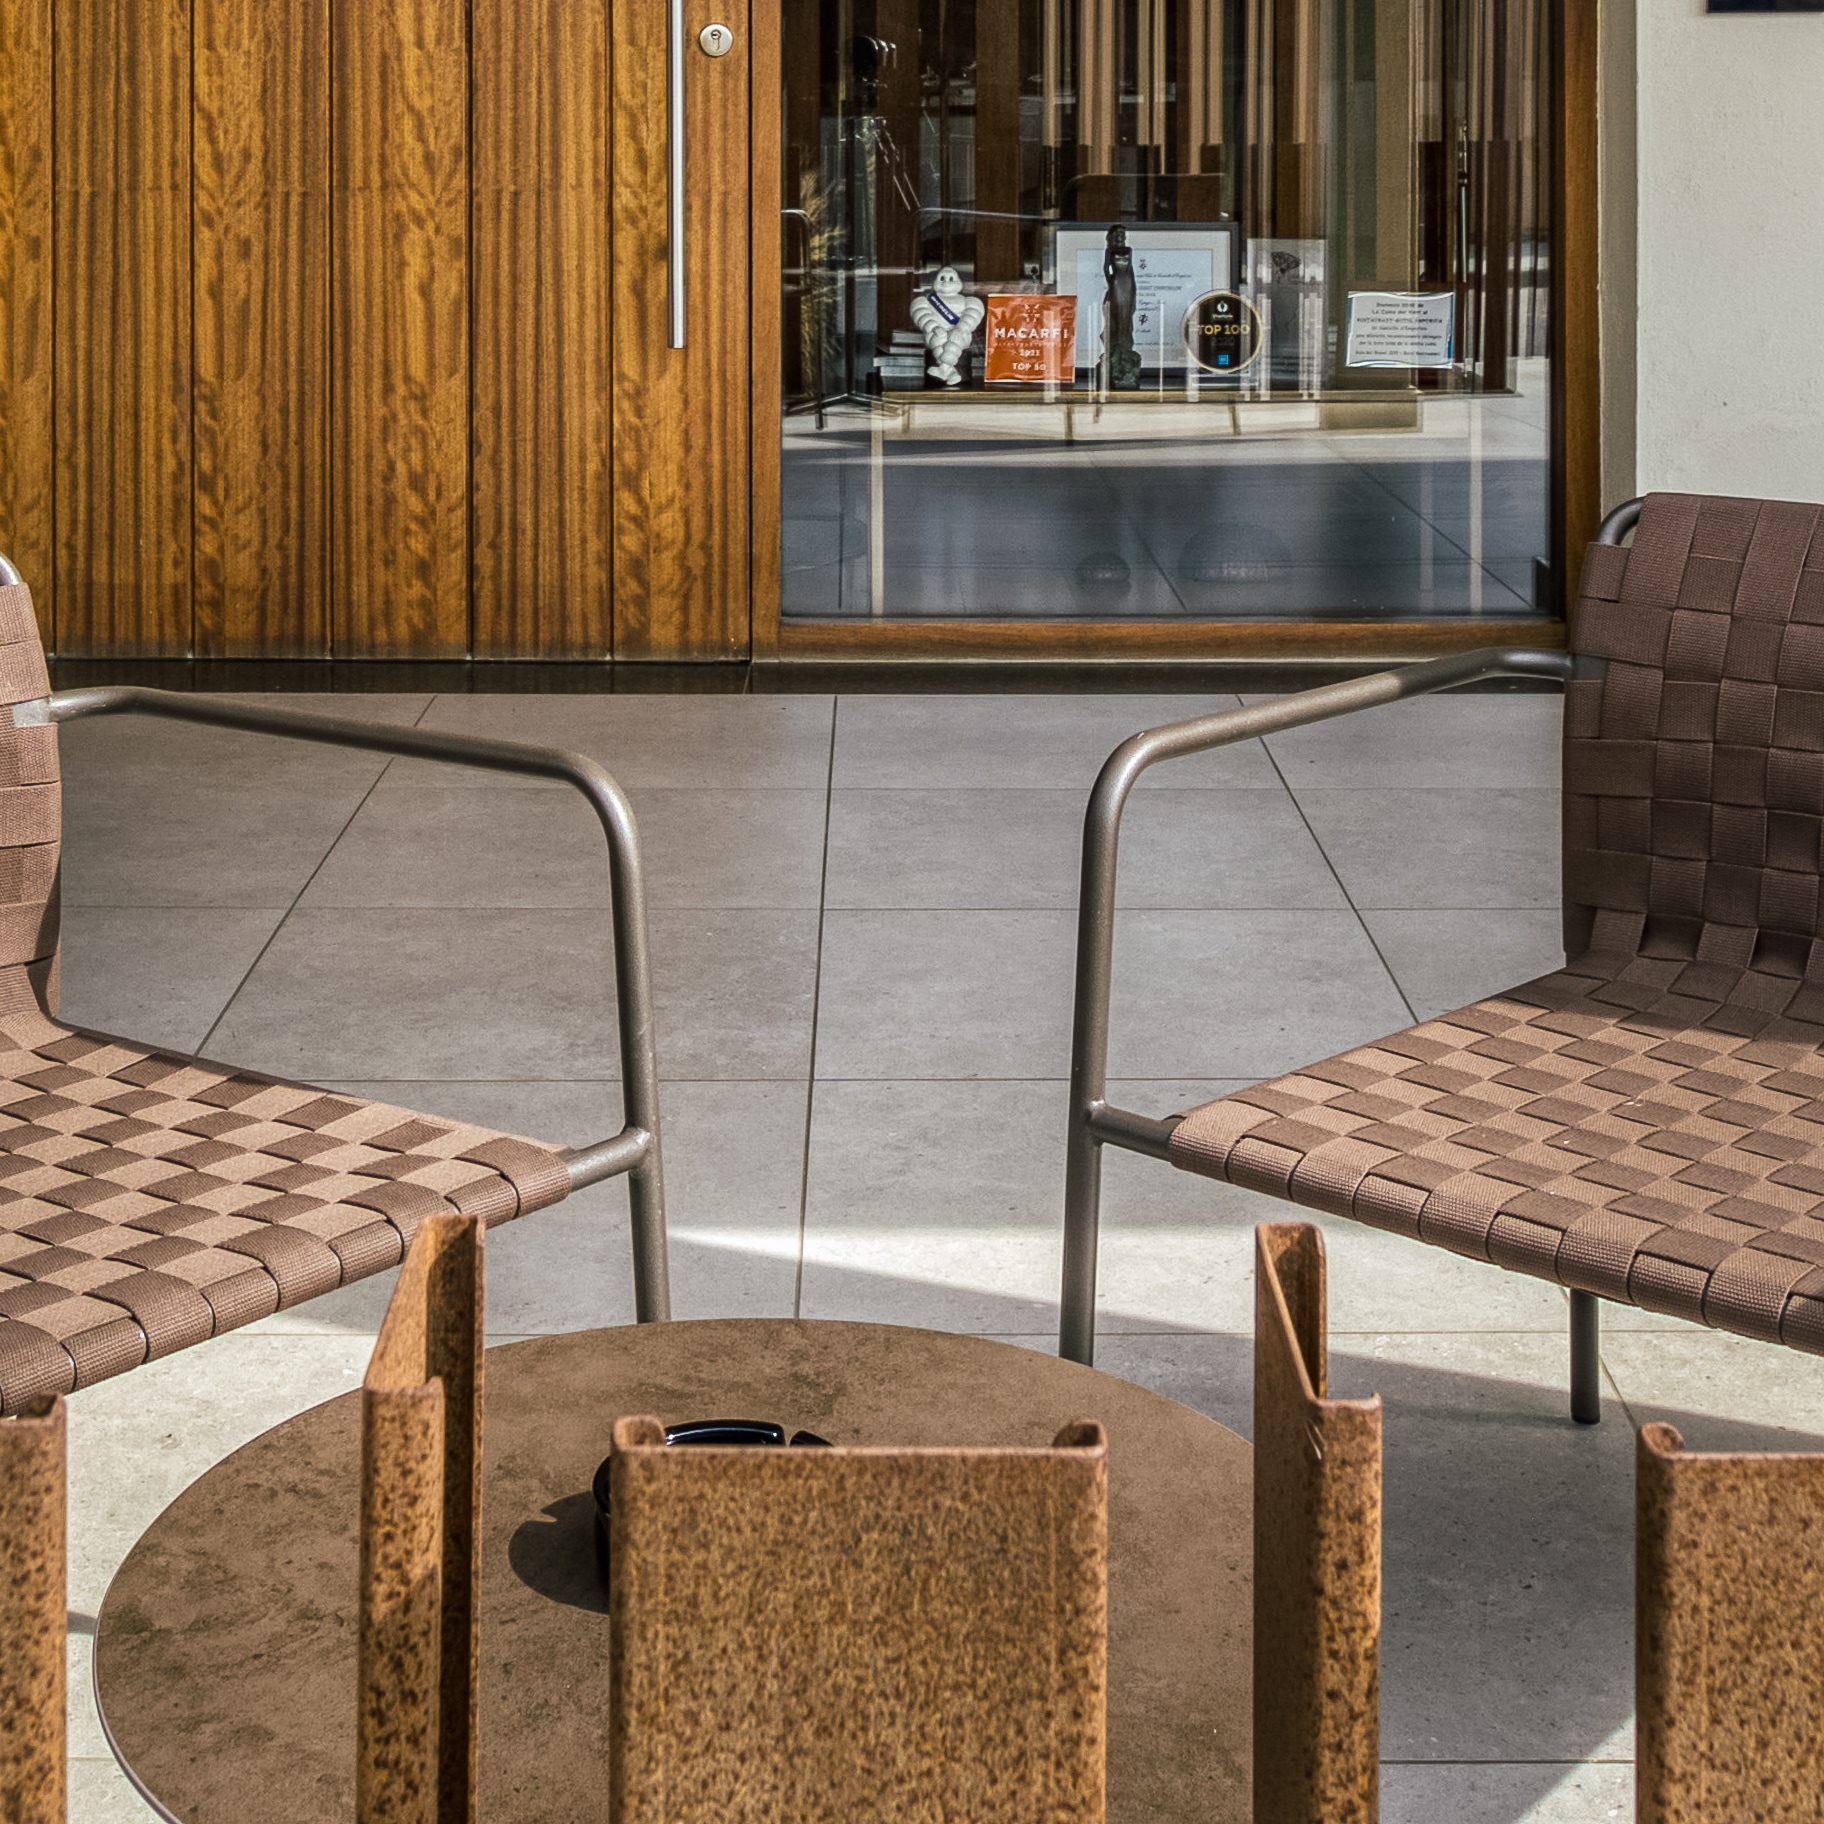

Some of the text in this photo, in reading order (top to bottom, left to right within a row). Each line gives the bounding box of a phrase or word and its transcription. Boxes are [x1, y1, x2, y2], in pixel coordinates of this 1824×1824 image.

[994, 327, 1069, 339] MACARFI
[1197, 323, 1251, 336] TOP 100
